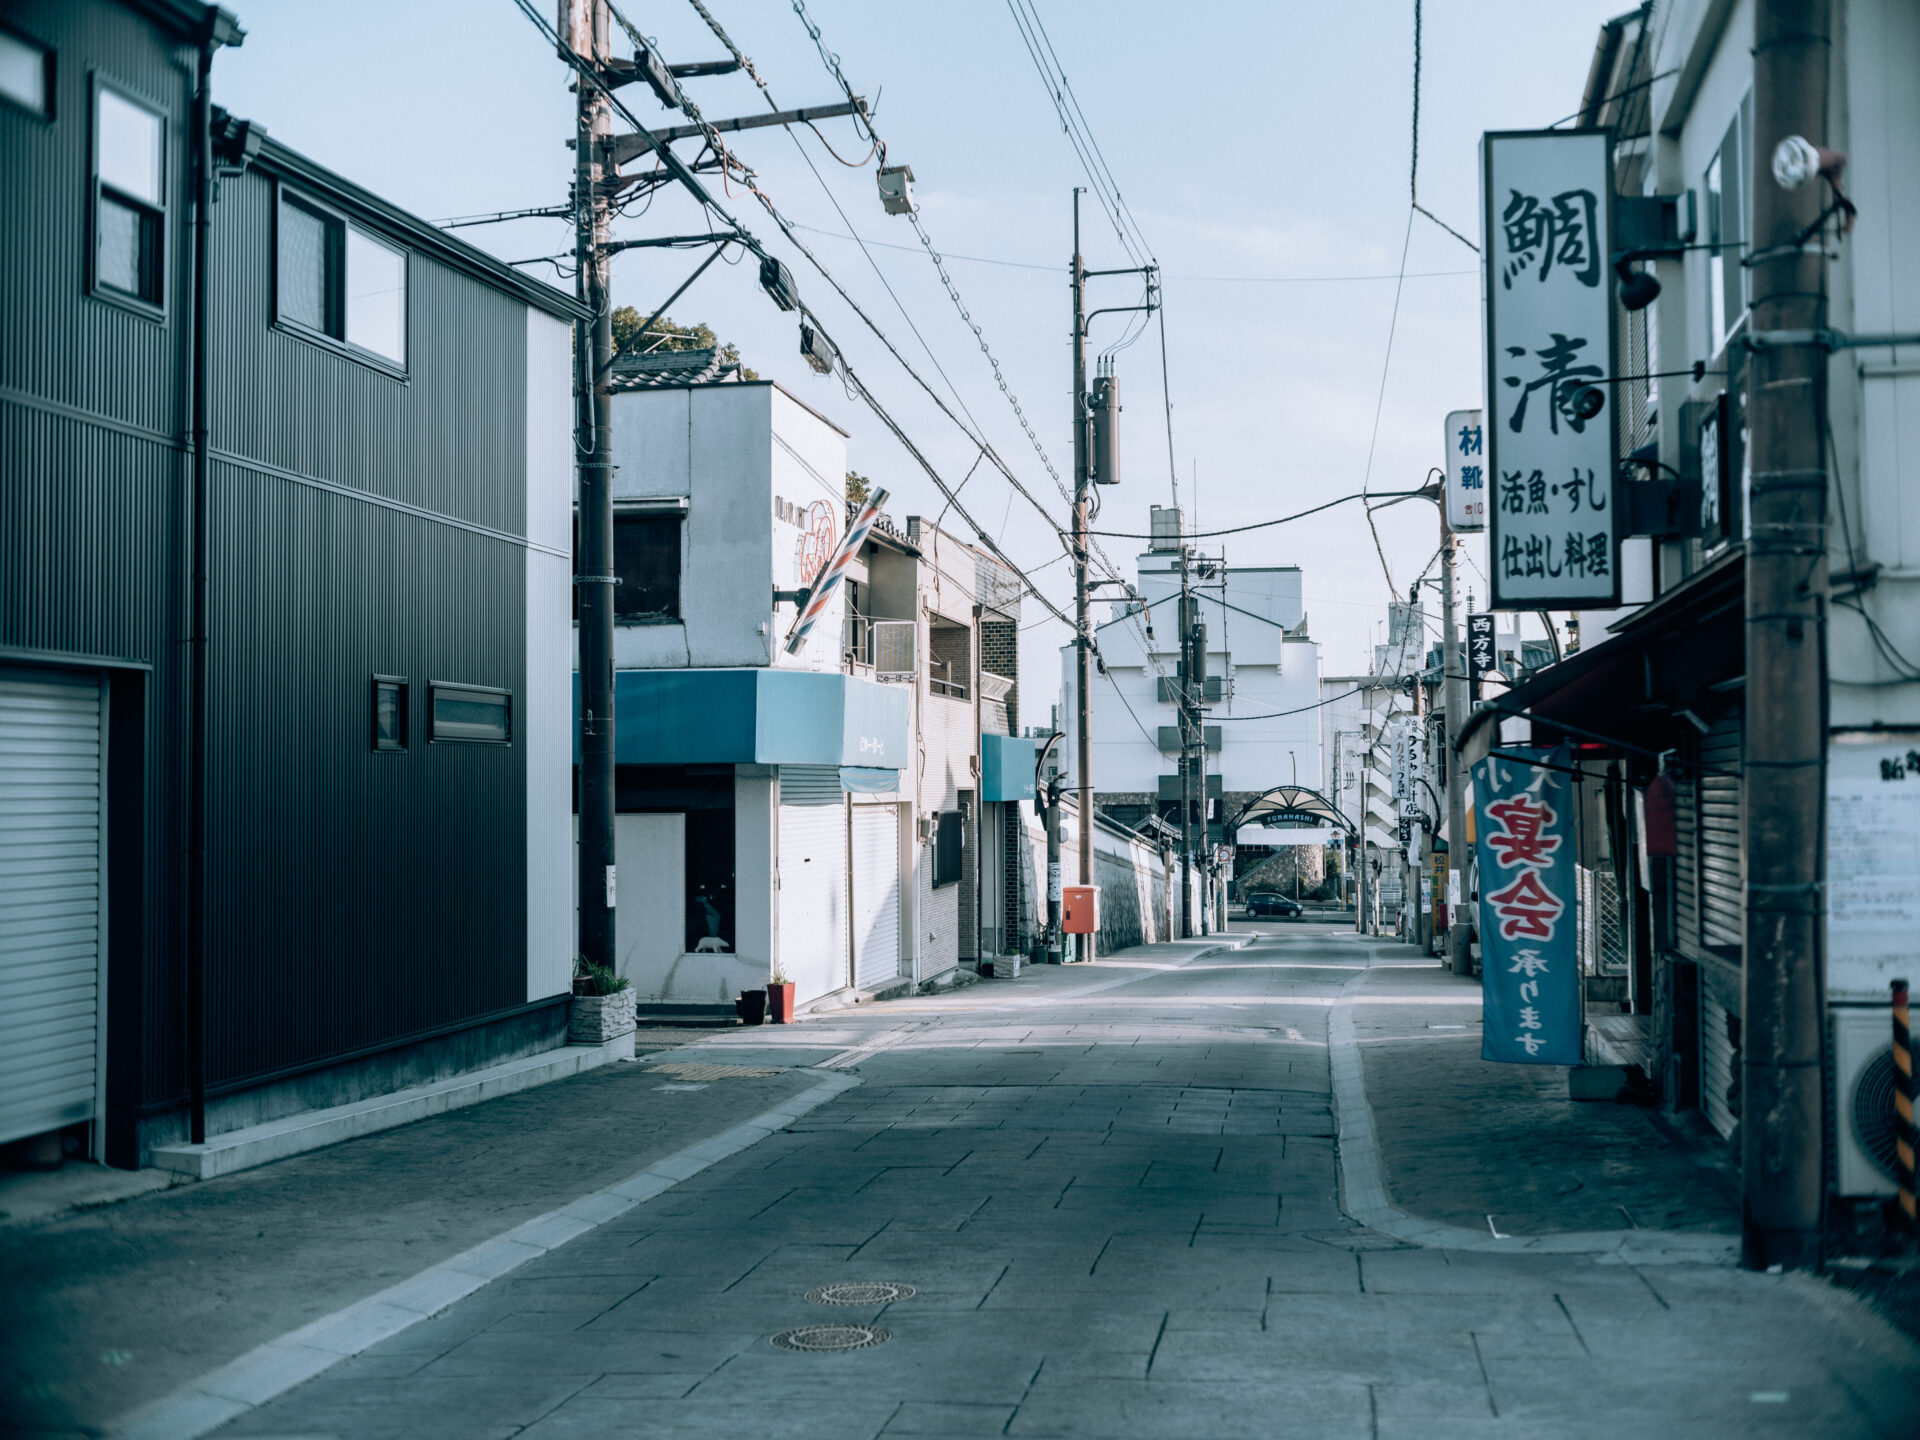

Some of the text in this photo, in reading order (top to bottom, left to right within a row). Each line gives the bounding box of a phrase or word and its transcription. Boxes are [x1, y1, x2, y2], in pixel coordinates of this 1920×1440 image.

[1502, 188, 1605, 435] 鯛清
[1501, 531, 1609, 579] 仕出し料理
[1471, 617, 1492, 668] 西方寺
